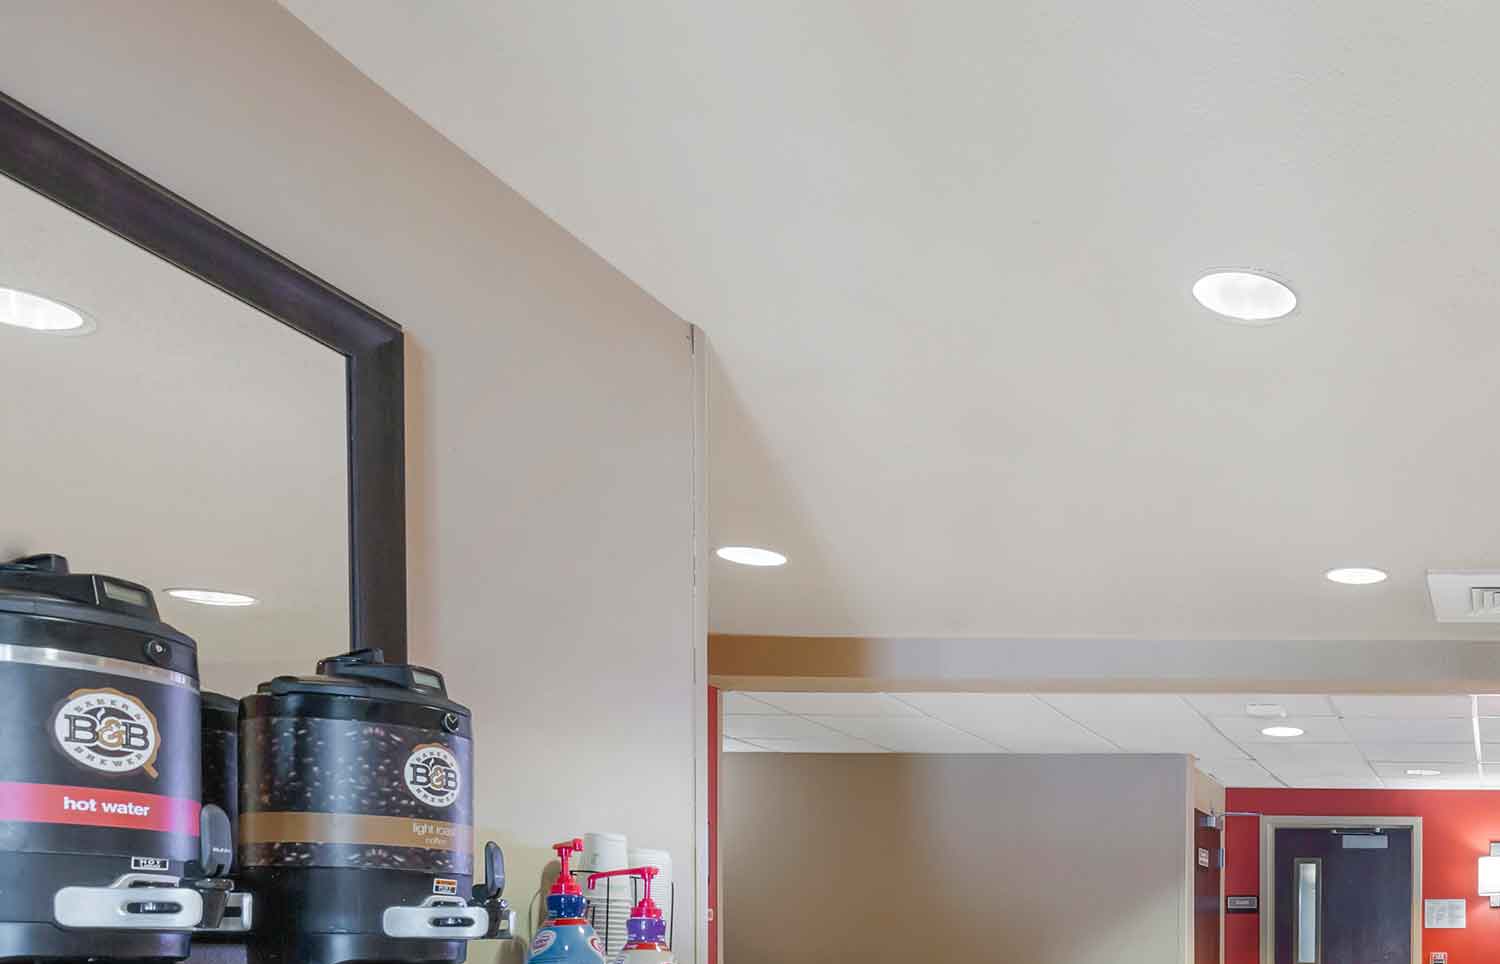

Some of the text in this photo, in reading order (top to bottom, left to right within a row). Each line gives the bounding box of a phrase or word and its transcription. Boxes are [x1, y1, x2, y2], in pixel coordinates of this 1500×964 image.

[63, 713, 150, 751] B&B
[409, 763, 458, 791] B&B
[63, 796, 150, 817] hot water
[412, 823, 434, 836] light
